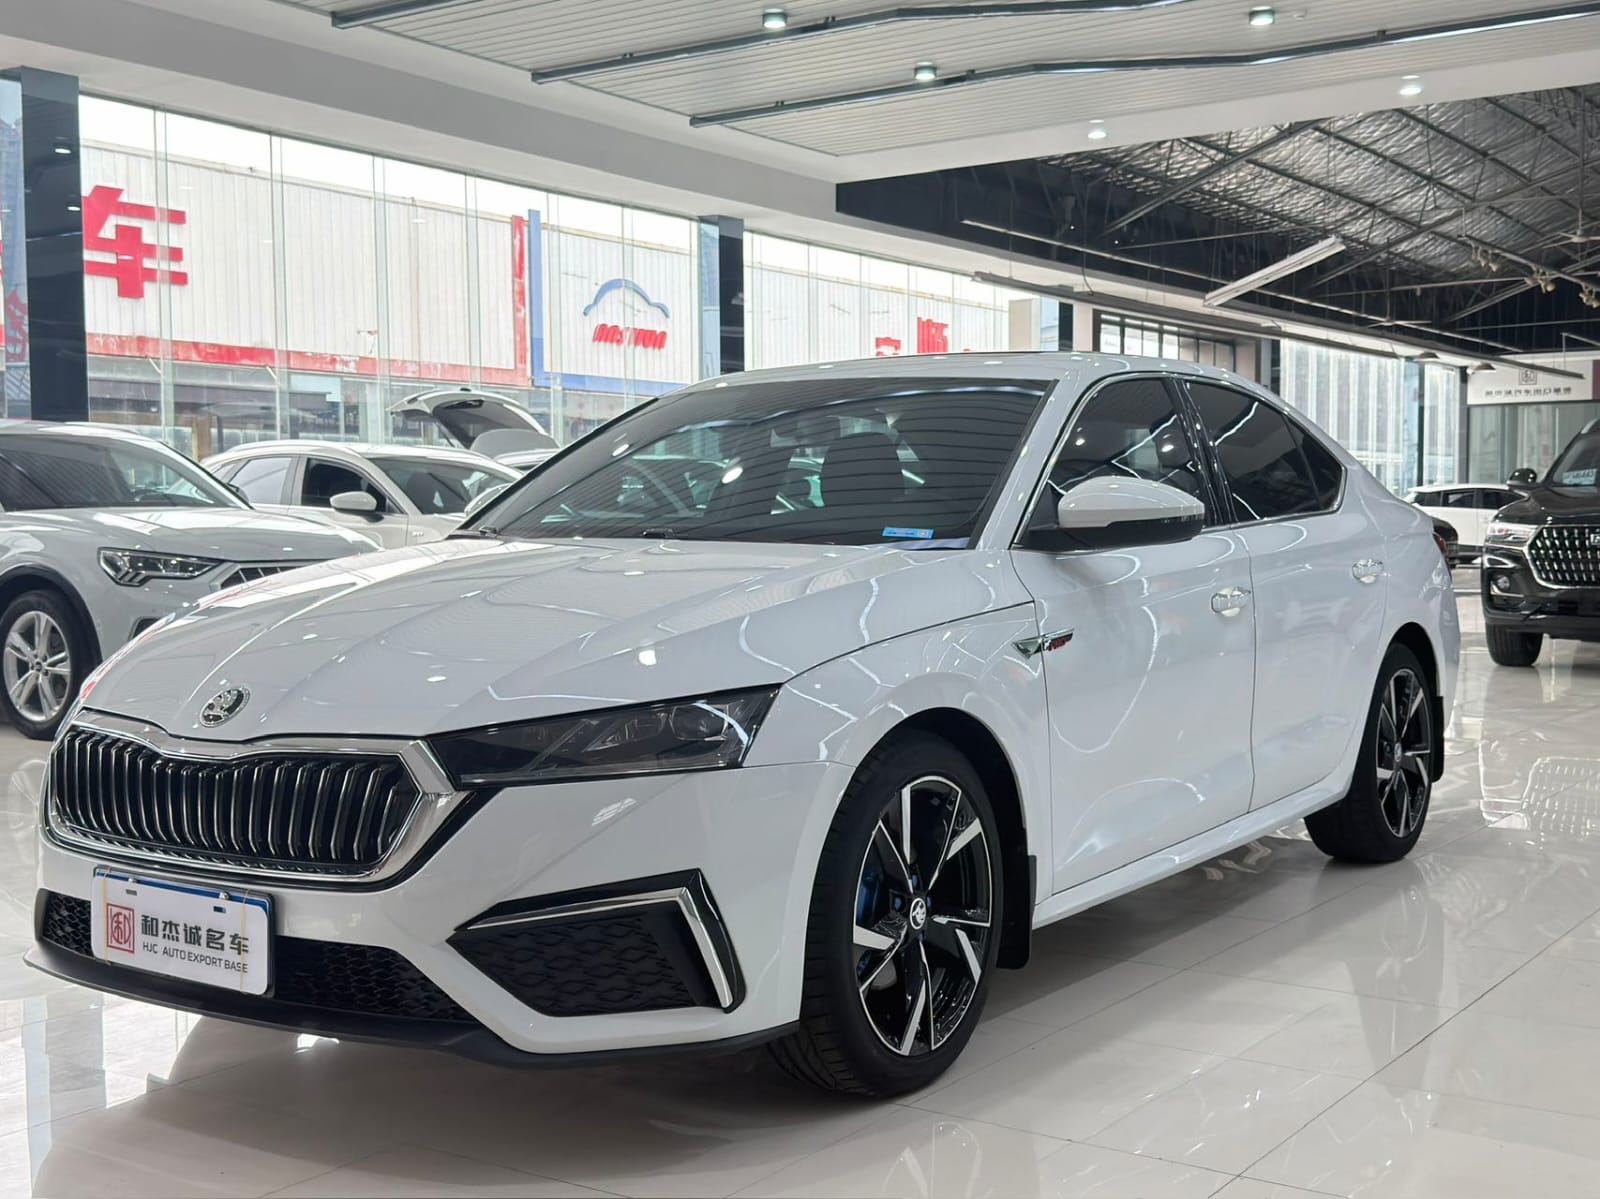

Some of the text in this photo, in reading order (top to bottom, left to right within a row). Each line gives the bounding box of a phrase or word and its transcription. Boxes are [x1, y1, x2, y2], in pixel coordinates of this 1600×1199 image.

[141, 914, 249, 956] 和杰诚名车
[142, 941, 249, 974] HJC AUTO EXPORT BASE
